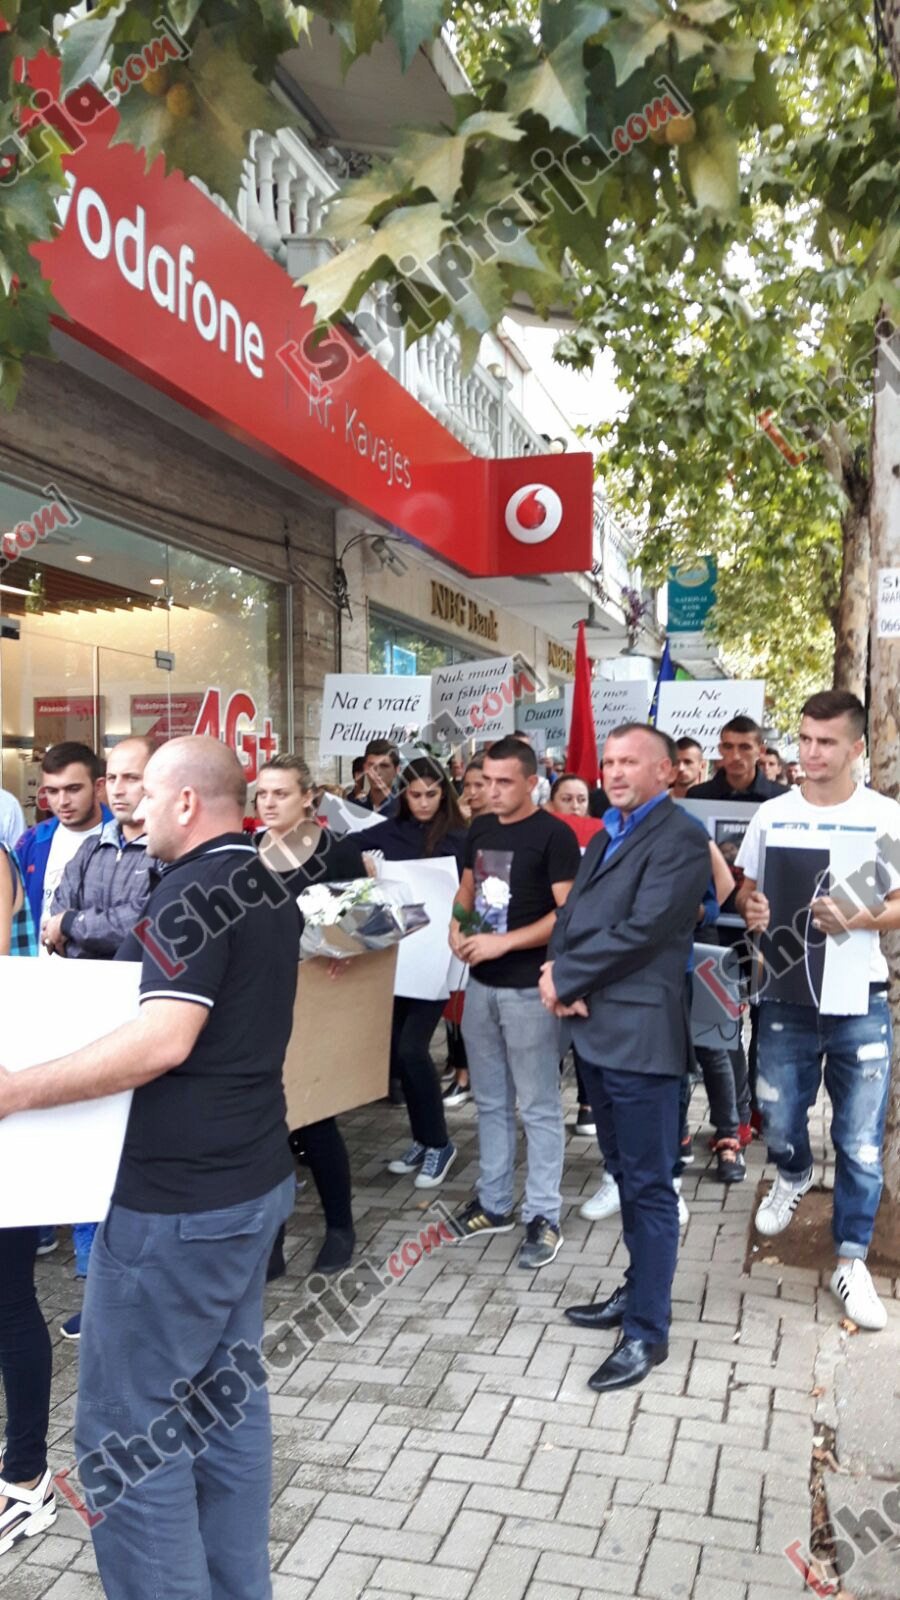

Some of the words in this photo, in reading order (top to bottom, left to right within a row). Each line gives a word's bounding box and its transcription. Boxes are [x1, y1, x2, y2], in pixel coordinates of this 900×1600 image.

[345, 400, 412, 489] Kavajes
[431, 580, 466, 626] NBG
[467, 600, 498, 641] Bank
[436, 670, 464, 685] Nuk
[468, 662, 508, 679] mund
[331, 691, 358, 710] Na
[363, 697, 373, 711] e
[377, 694, 422, 712] vratë
[440, 692, 454, 702] ta
[698, 689, 722, 700] Ne
[524, 707, 564, 723] Duam
[670, 706, 702, 719] nuk
[706, 706, 728, 719] do
